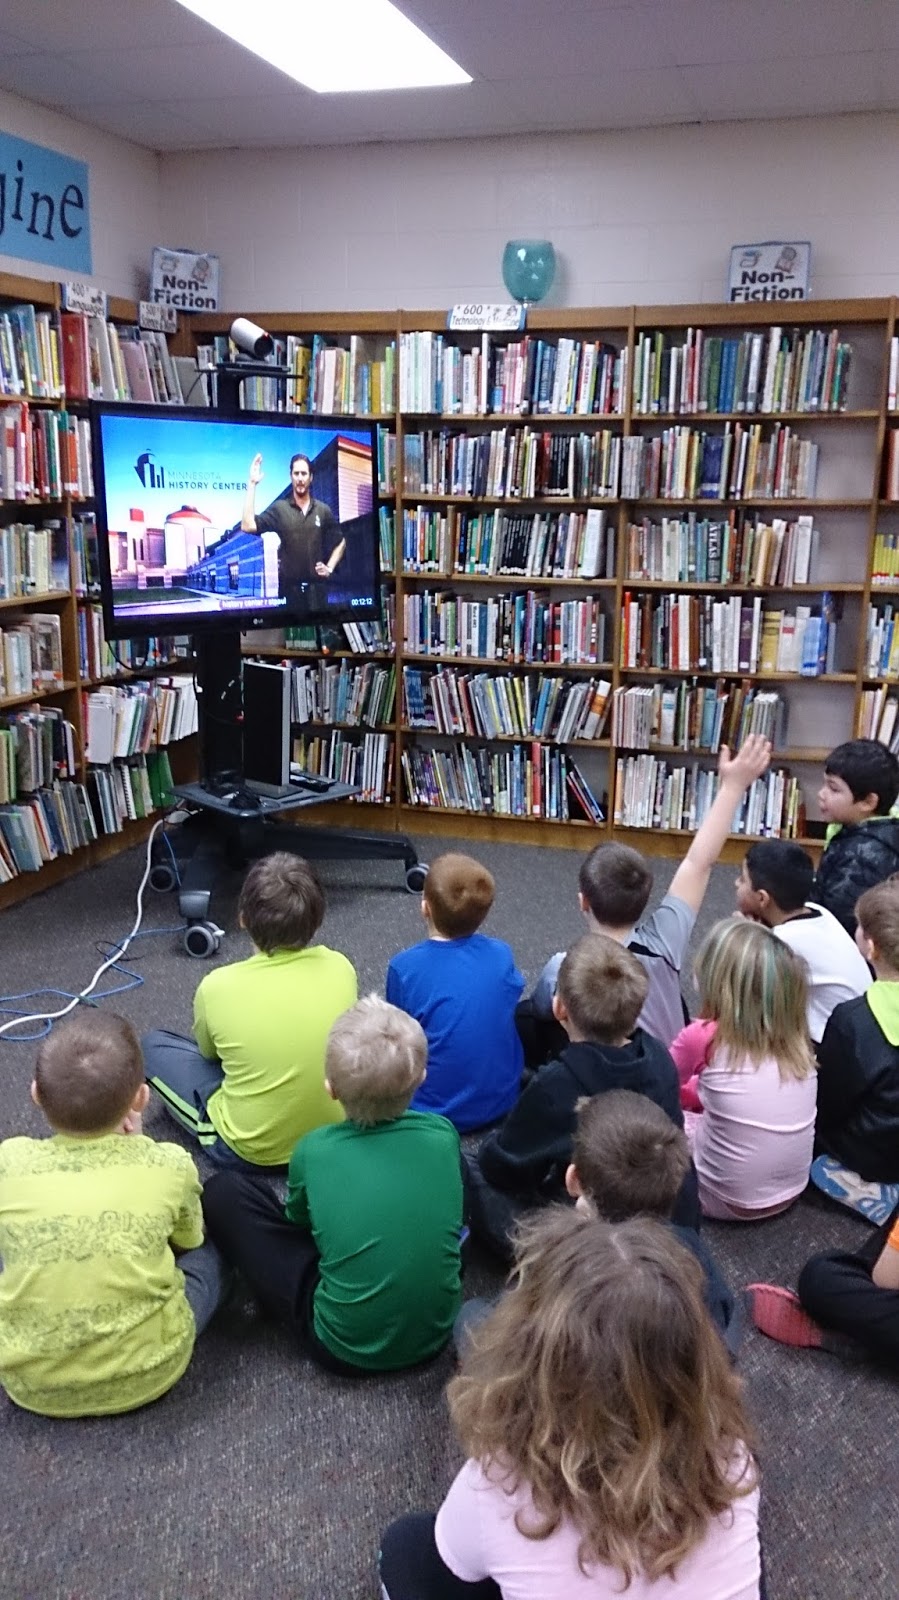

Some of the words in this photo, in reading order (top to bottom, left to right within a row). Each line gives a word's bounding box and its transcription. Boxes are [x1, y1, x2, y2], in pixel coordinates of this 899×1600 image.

[162, 274, 208, 291] Non-
[741, 270, 795, 285] Non-
[154, 288, 217, 310] Fiction
[730, 285, 804, 301] Fiction
[463, 305, 483, 315] 600
[452, 316, 485, 328] Technology
[168, 471, 222, 480] MINNESOTA
[212, 482, 248, 491] CENTER
[709, 524, 718, 558] ATLAS
